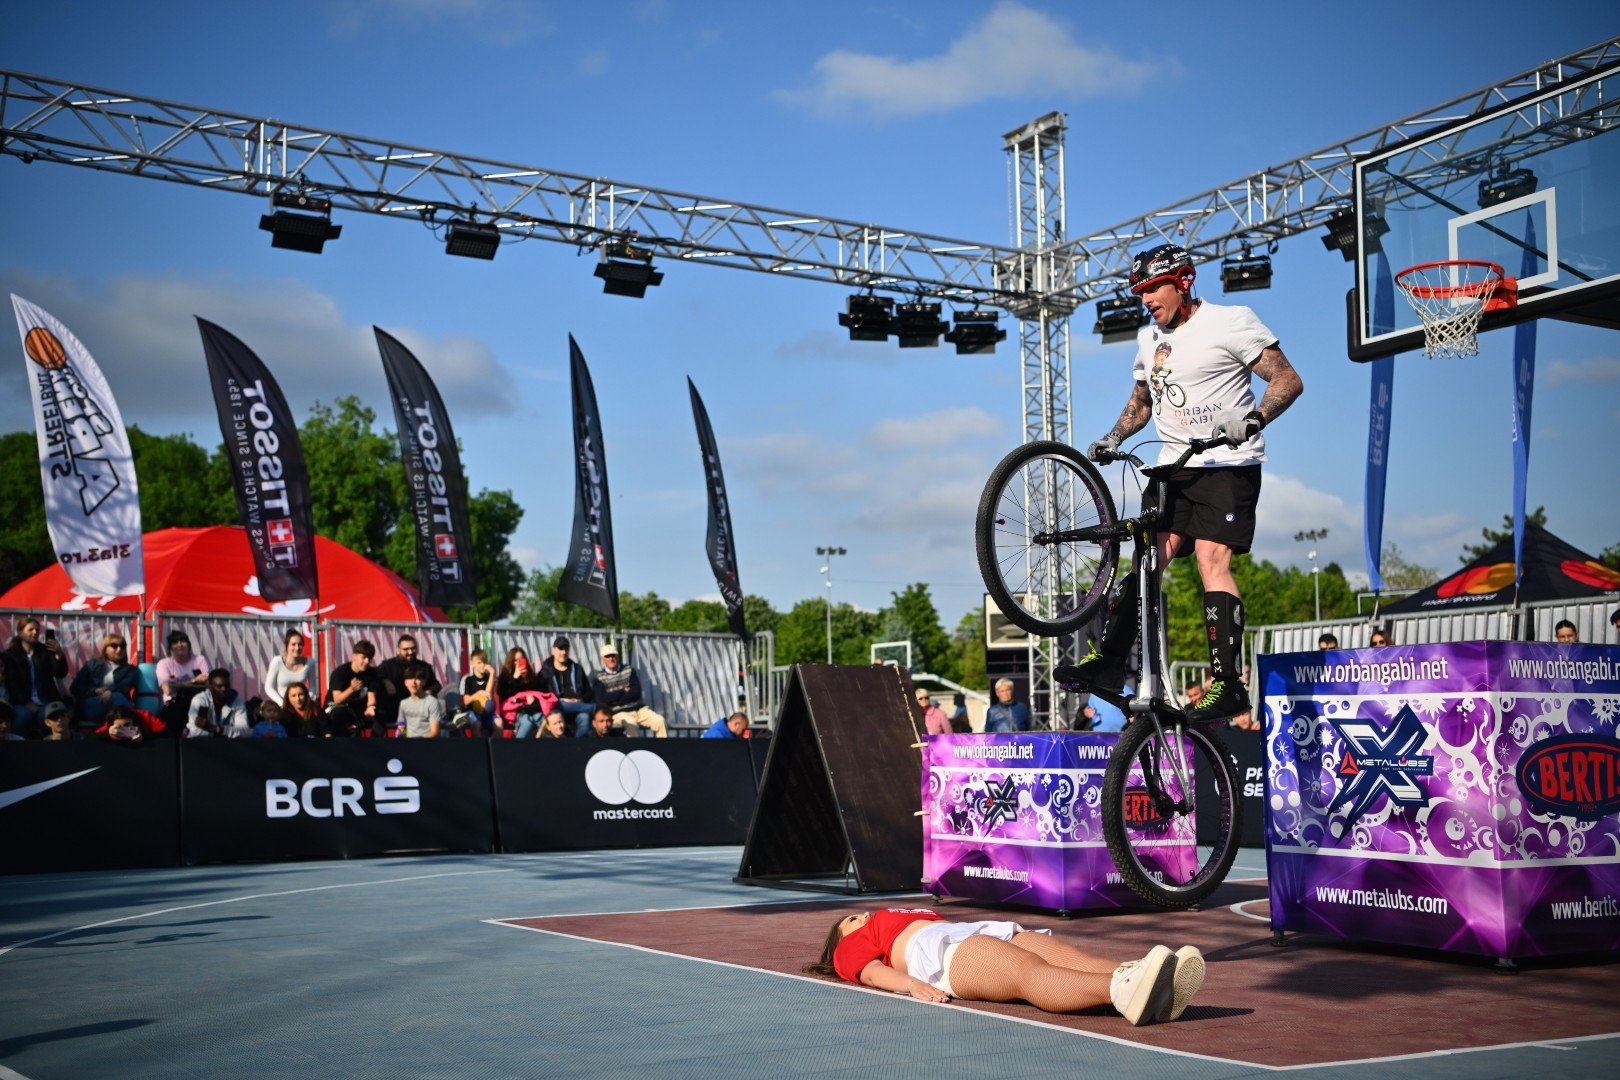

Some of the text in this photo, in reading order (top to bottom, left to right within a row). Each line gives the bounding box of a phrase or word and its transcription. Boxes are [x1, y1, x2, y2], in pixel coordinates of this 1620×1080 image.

[1174, 402, 1222, 418] ORBAN
[1180, 415, 1213, 427] GABI
[1212, 648, 1222, 673] FAM
[1294, 657, 1448, 686] www.orbangabi.net
[953, 742, 1033, 762] www.orbangabi.net
[1356, 758, 1428, 767] METALUBS
[265, 777, 366, 818] BCR
[593, 806, 674, 820] mastercard
[964, 865, 1029, 882] www.metalubs.com
[1316, 885, 1448, 915] www.metalubs.com
